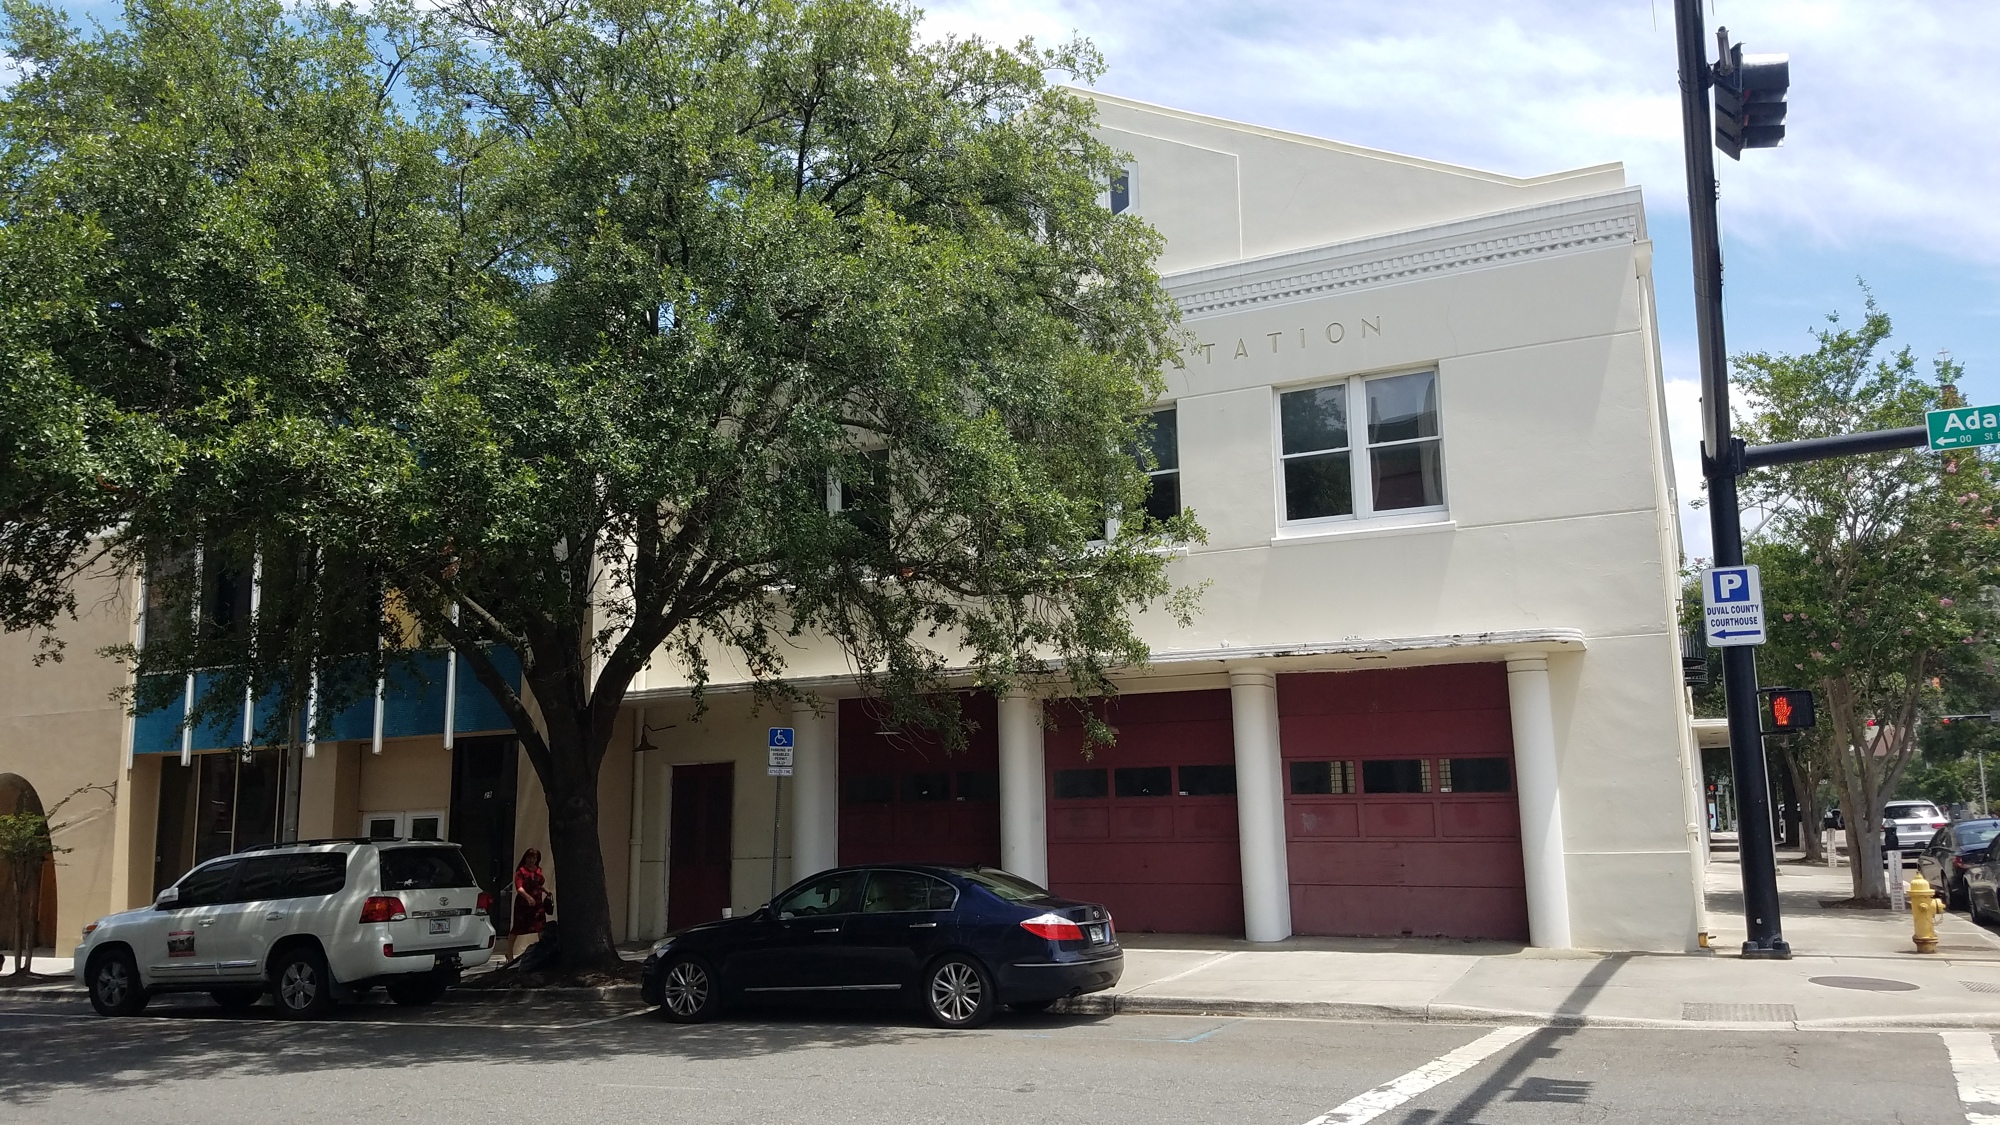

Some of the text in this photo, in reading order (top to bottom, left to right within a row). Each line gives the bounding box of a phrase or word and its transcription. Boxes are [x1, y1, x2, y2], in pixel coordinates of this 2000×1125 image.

[1959, 434, 1972, 443] 00
[1984, 432, 1993, 441] St
[1719, 573, 1742, 599] P
[1706, 604, 1759, 616] DUVAL COUNTY
[1710, 616, 1758, 627] COURTHOUSE
